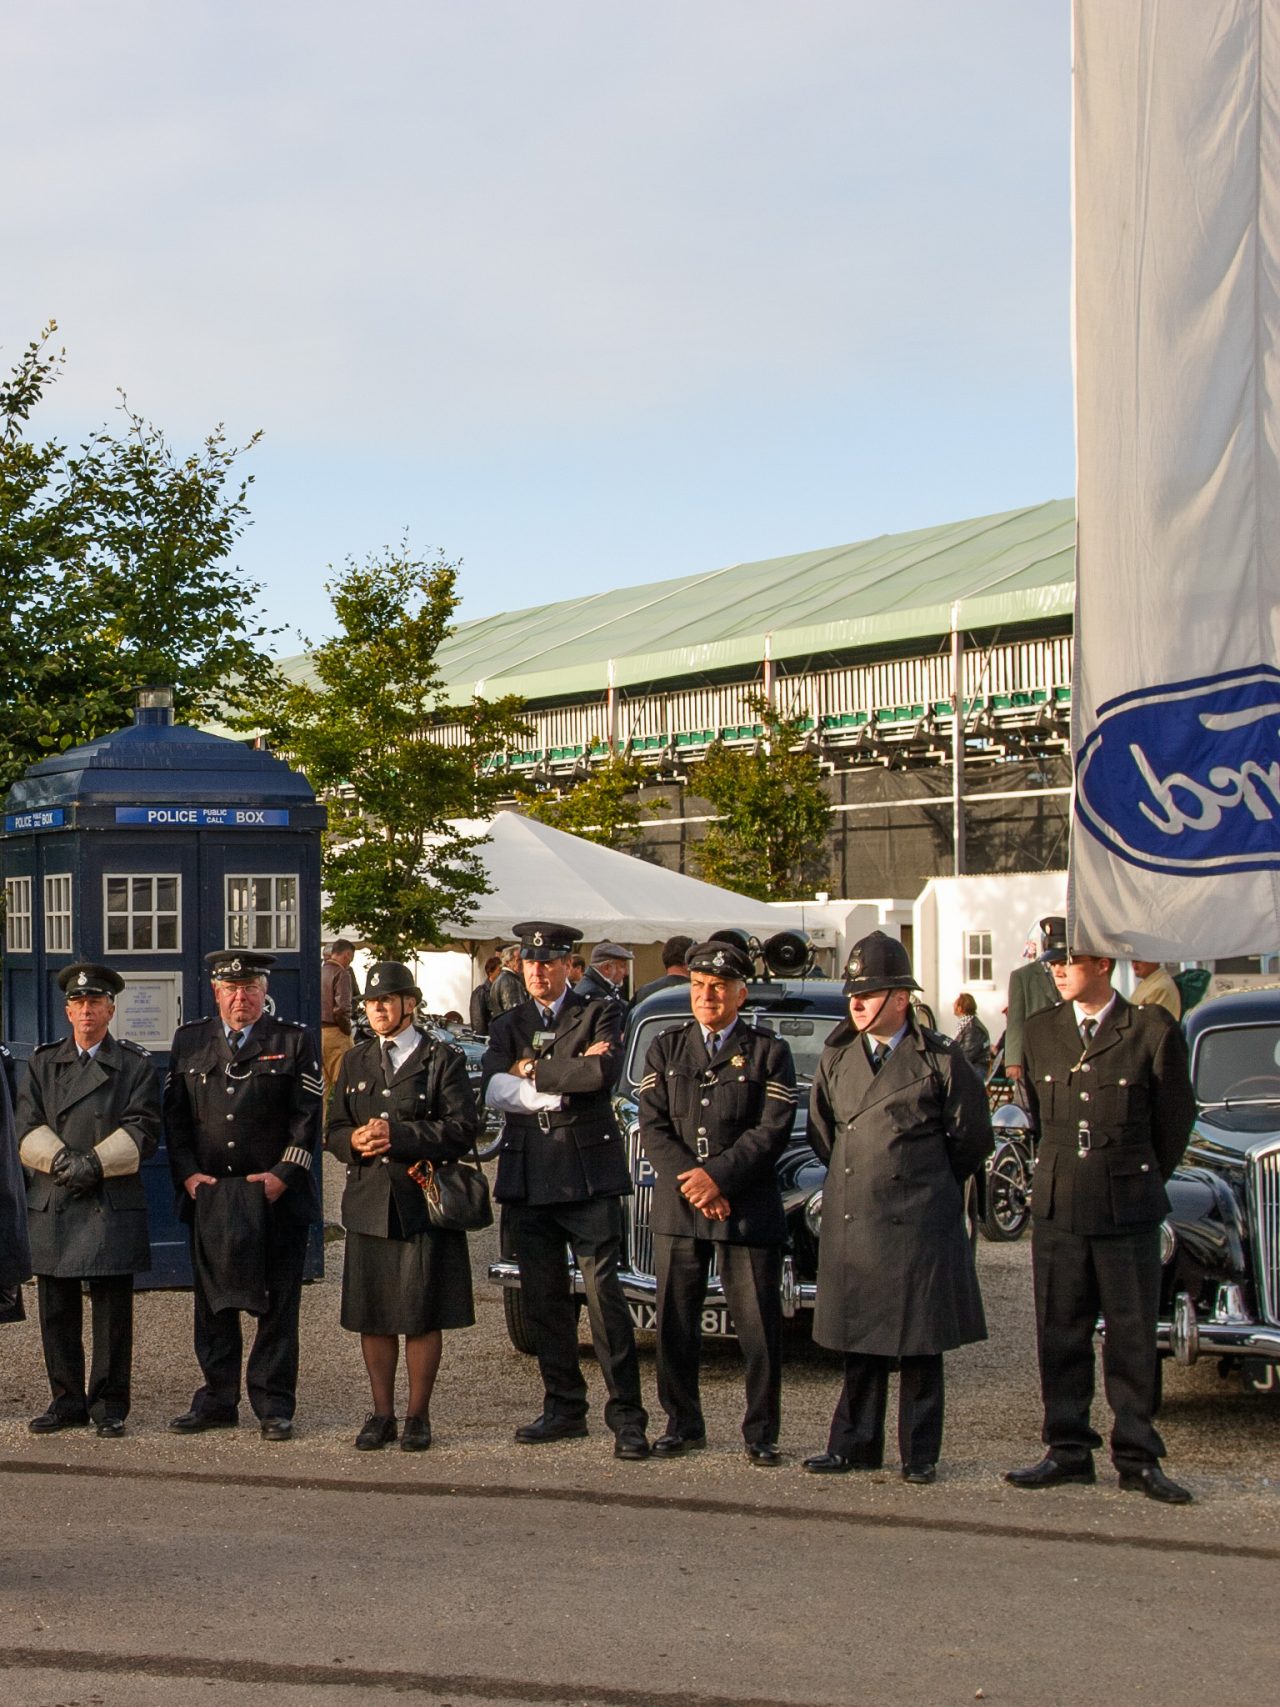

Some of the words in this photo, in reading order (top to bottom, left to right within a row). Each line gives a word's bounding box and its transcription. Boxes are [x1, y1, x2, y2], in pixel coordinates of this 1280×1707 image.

[15, 815, 32, 828] POLICE
[42, 812, 54, 825] BOX
[147, 810, 198, 823] POLICE
[206, 816, 224, 824] CALL
[236, 811, 265, 823] BOX
